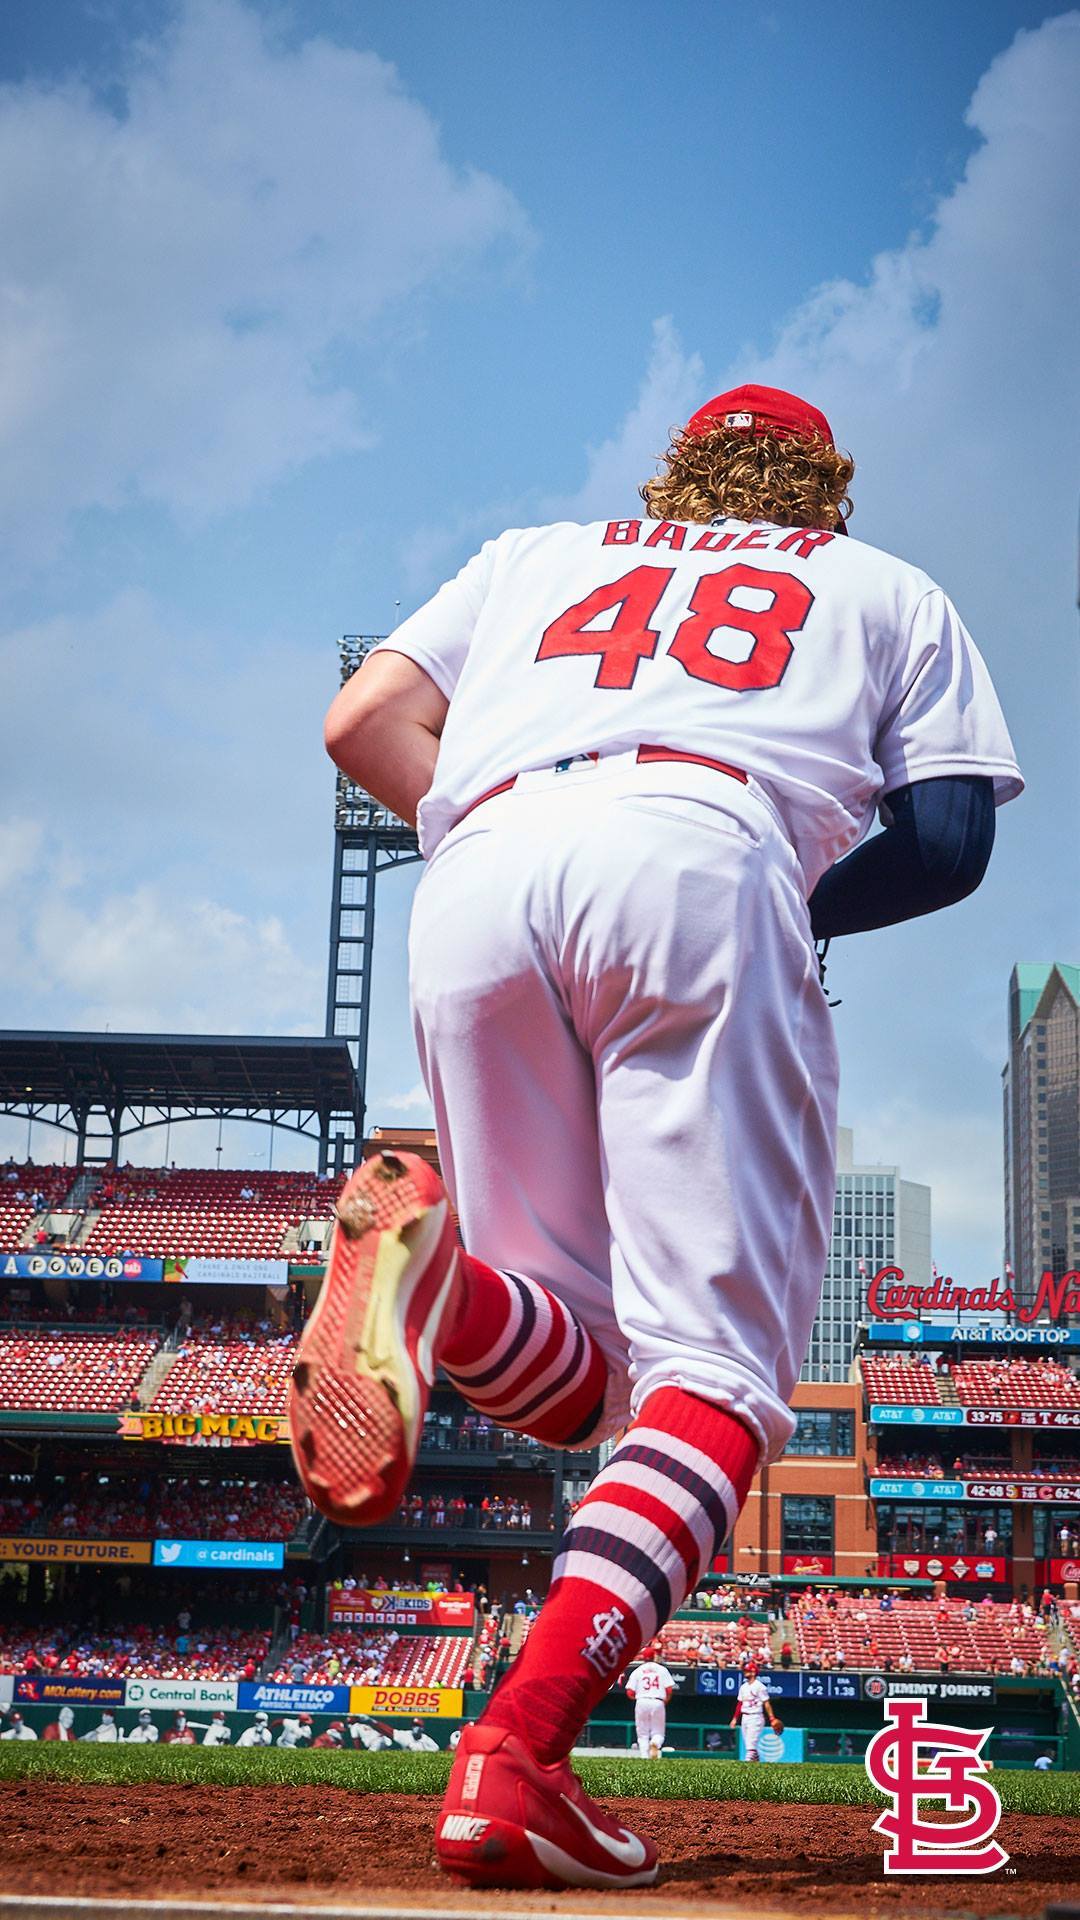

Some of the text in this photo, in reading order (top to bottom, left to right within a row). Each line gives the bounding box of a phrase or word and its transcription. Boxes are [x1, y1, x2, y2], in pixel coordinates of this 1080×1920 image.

[602, 520, 836, 560] BADER
[535, 563, 816, 693] 48
[32, 1258, 119, 1275] POWER
[867, 1266, 1017, 1319] Cardinals
[951, 1327, 1070, 1343] AT&T ROOFTOP
[879, 1410, 903, 1420] AT&T
[932, 1411, 957, 1421] AT&T
[971, 1411, 1003, 1422] 33-75
[142, 1415, 279, 1442] BIG MAC
[879, 1483, 903, 1494] AT&T
[933, 1484, 957, 1495] AT&T
[13, 1543, 58, 1556] YOUR
[63, 1545, 134, 1558] FUTURE.
[405, 1599, 431, 1609] KIDS
[642, 1676, 659, 1690] 34
[725, 1677, 735, 1690] 0
[806, 1686, 824, 1695] 4-2
[888, 1682, 938, 1696] JIMMY
[940, 1684, 992, 1698] JOHN'S
[150, 1688, 235, 1701] Central Bank
[253, 1686, 335, 1703] ATHLETICO
[374, 1691, 440, 1706] DOBBS
[440, 1815, 492, 1841] NIKE
